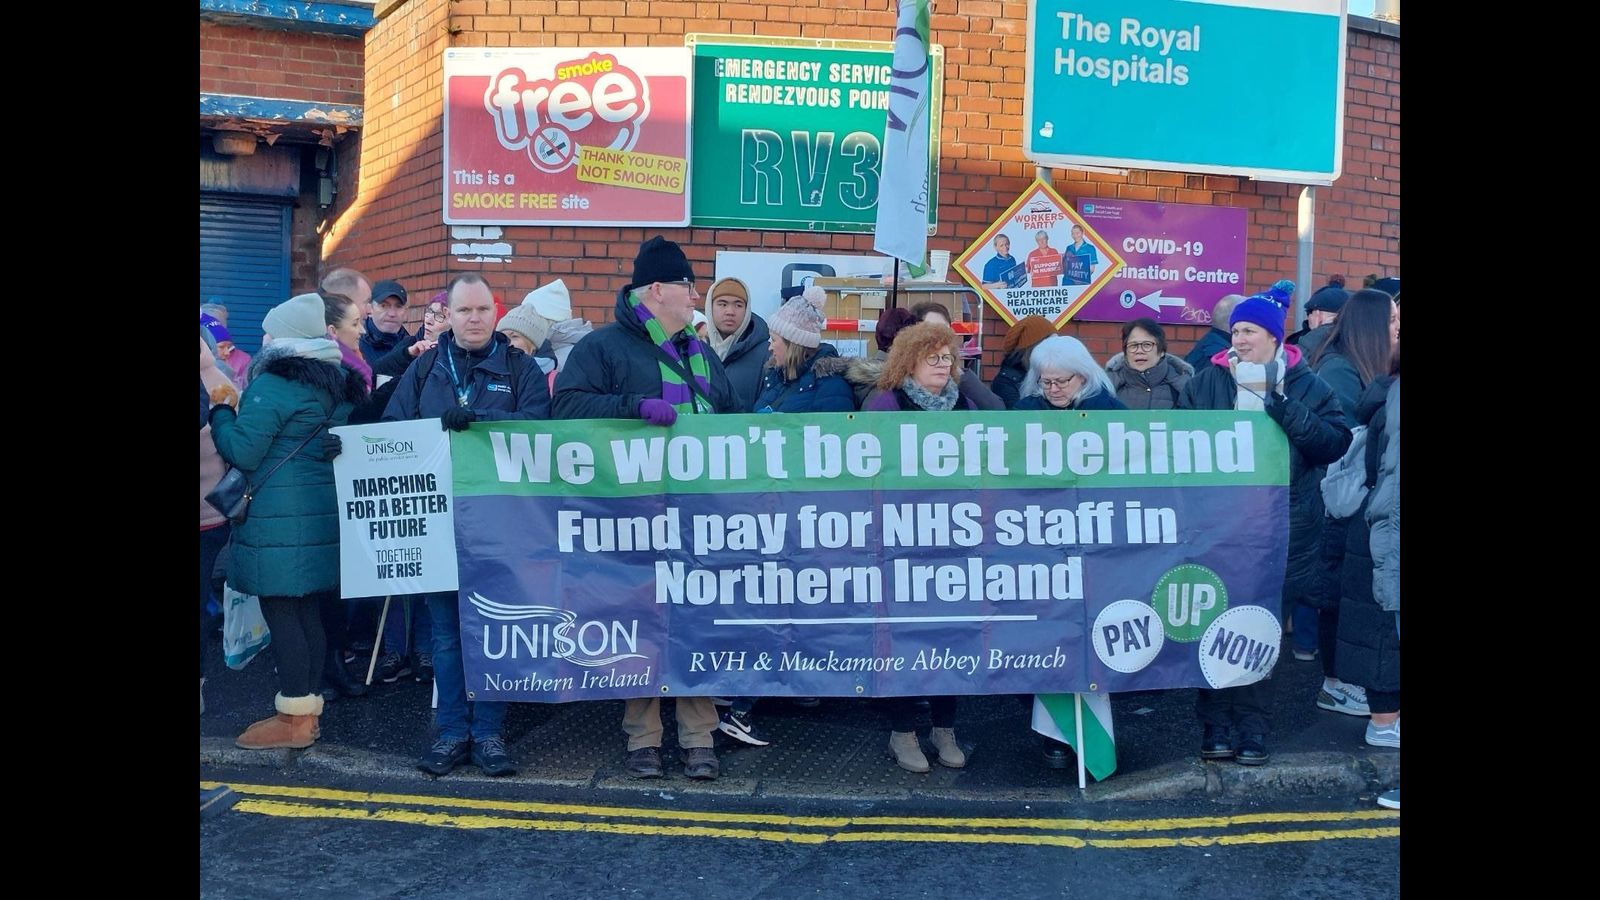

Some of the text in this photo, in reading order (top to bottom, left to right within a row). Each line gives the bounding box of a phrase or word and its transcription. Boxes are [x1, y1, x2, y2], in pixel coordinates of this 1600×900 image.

[1056, 11, 1200, 56] The Royal
[557, 58, 613, 80] smoke
[715, 58, 891, 85] EMERGENCY SERVIC
[1054, 48, 1189, 87] Hospitals
[493, 72, 638, 139] free
[725, 84, 889, 110] RENDEZVOUS POIN
[583, 149, 681, 172] THANK YOU FOR
[740, 129, 881, 210] RV3
[453, 170, 514, 185] This is a
[580, 164, 680, 188] NOT SMOKING
[453, 193, 589, 210] SMOKE FREE site
[1015, 213, 1064, 223] WORKERS
[1024, 221, 1055, 230] PARTY
[1122, 237, 1204, 257] COVID-19
[1113, 265, 1239, 284] cination Centre
[1006, 288, 1068, 299] SUPPORTING
[1007, 297, 1068, 307] HEALTHCARE
[1013, 306, 1061, 316] WORKERS
[366, 441, 413, 455] UNISON
[488, 421, 1255, 485] We won't be left behind
[352, 473, 437, 498] MARCHING
[346, 494, 448, 520] FOR A BETTER
[369, 517, 427, 540] FUTURE
[557, 500, 1177, 556] Fund pay for NHS staff in
[376, 547, 422, 563] TOGETHER
[376, 561, 423, 579] WE RISE
[654, 556, 1084, 605] Northern Ireland
[483, 619, 639, 660] UNISON
[1103, 583, 1275, 673] PAY UP NOW!
[689, 647, 1066, 675] RVH & Muckamore Abbey Branch
[484, 667, 650, 692] Northern Ireland
